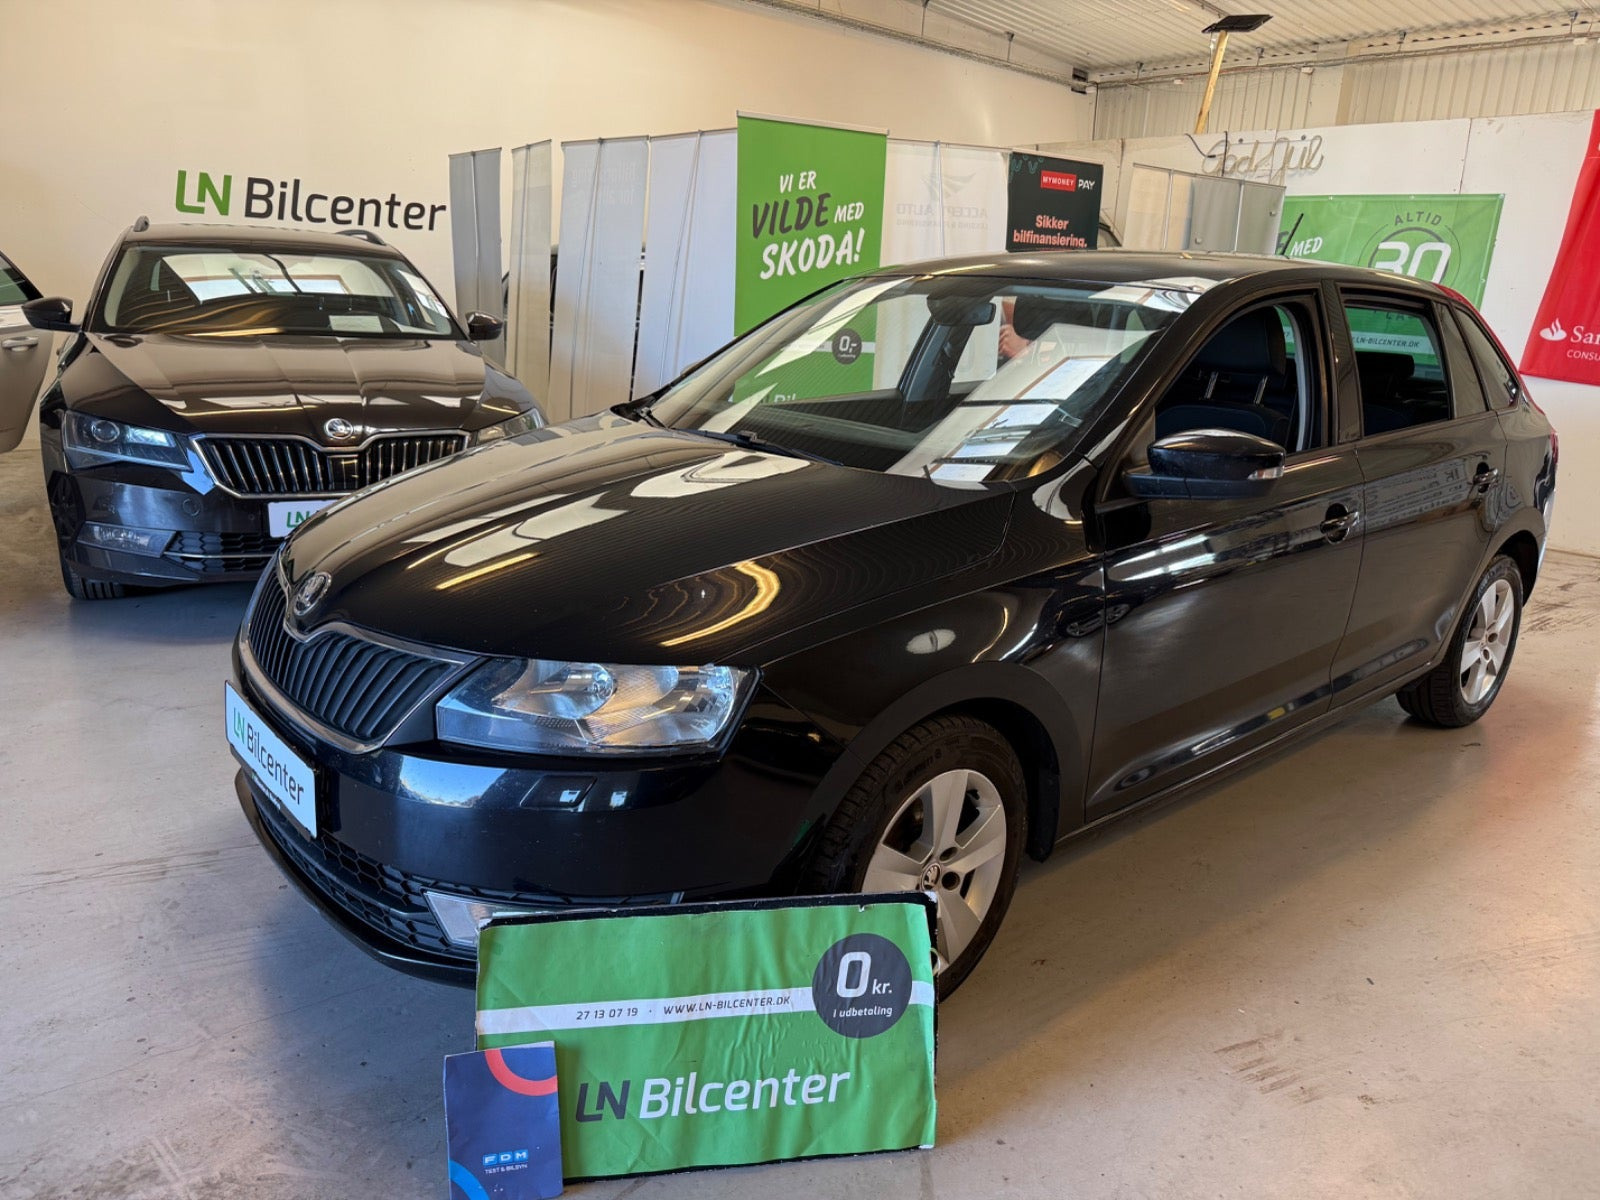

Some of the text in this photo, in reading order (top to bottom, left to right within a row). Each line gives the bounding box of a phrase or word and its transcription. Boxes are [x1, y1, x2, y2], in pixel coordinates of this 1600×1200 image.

[779, 170, 817, 194] VI ER
[1041, 175, 1096, 190] MYMONEY PAY
[176, 170, 447, 231] LN Bilcenter
[752, 192, 865, 239] VILDE MED
[1035, 214, 1070, 230] Sikker
[1394, 211, 1442, 226] ALTID
[1012, 229, 1088, 248] bilfinansiering.
[1290, 236, 1323, 257] MED
[760, 227, 866, 280] SKODA!
[233, 707, 245, 745] LN
[247, 722, 304, 805] Bilcenter
[836, 951, 893, 998] 0 kr.
[576, 996, 791, 1021] 27 13 07 19 WWW.LN-BILCENTER.DK
[839, 1005, 893, 1018] udbetaling
[575, 1068, 851, 1123] LN Bilcenter
[484, 1151, 527, 1164] FDM
